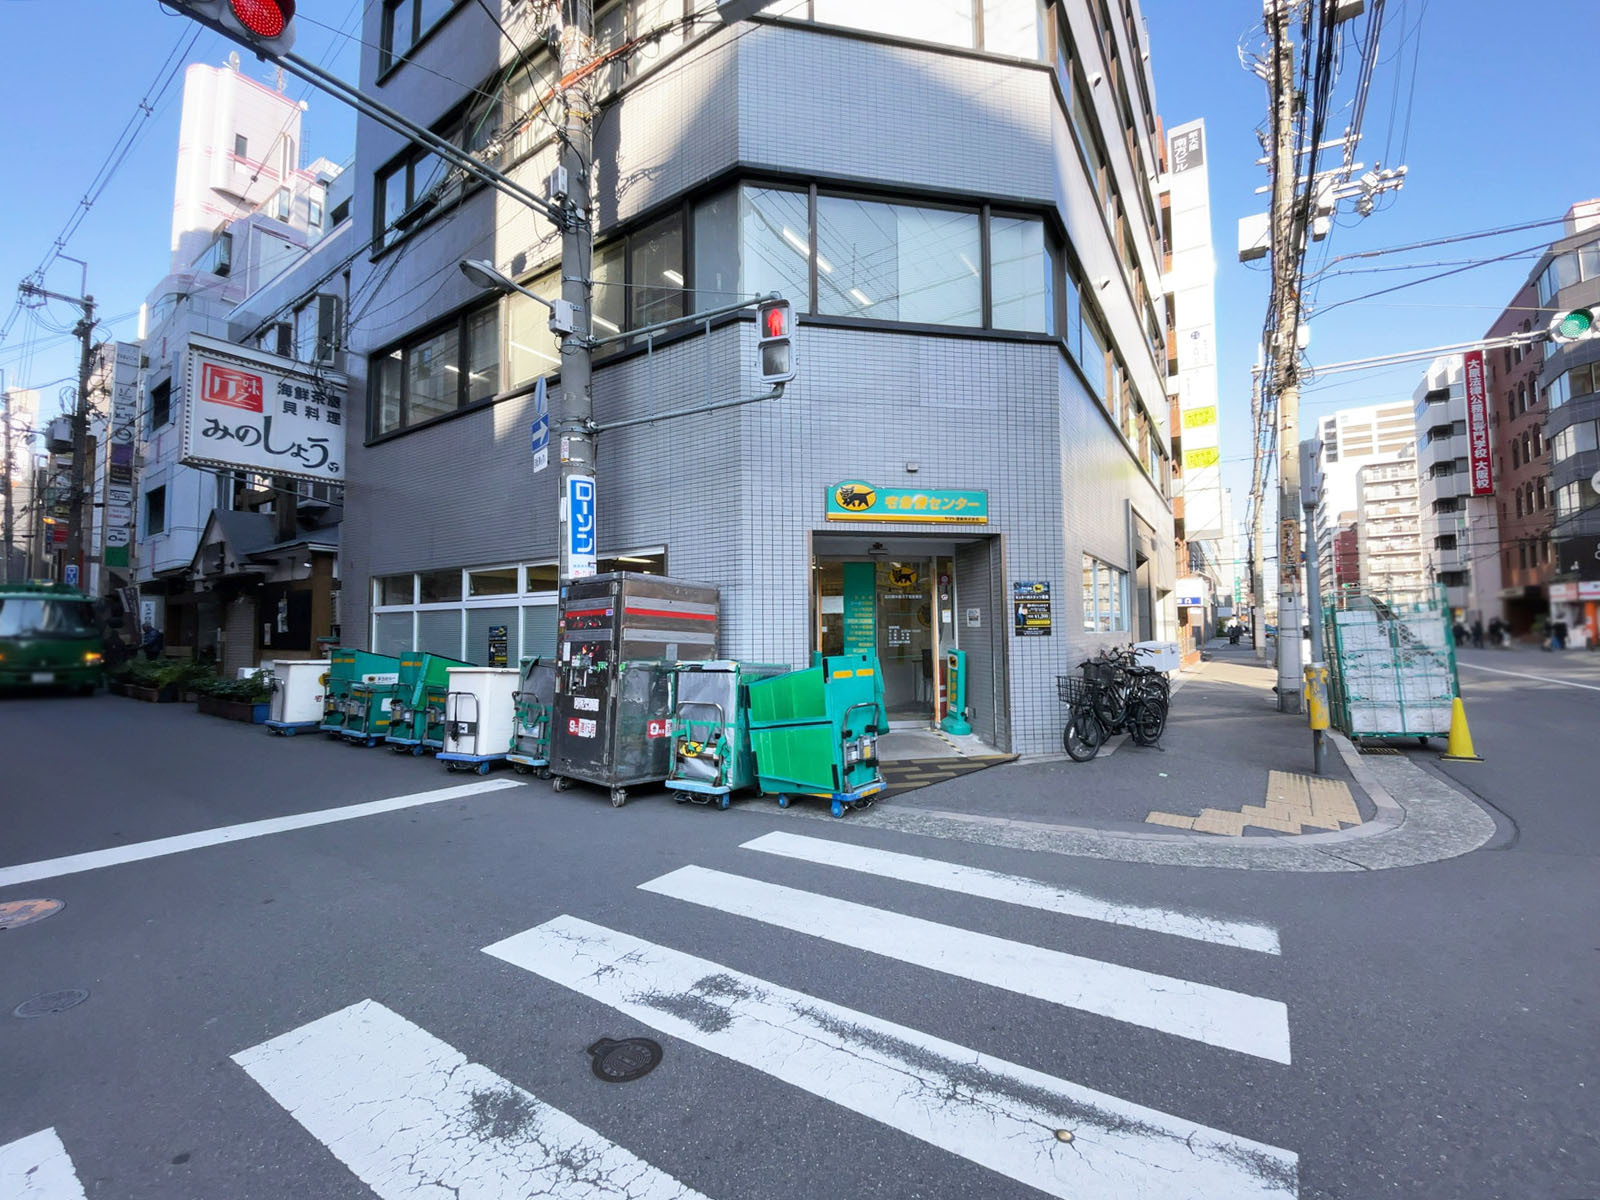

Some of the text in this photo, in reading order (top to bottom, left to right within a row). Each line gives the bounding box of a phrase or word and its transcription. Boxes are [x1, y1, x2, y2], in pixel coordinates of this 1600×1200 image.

[282, 400, 341, 425] 貝料理
[202, 416, 330, 468] みのしょう
[576, 482, 593, 553] ローソン
